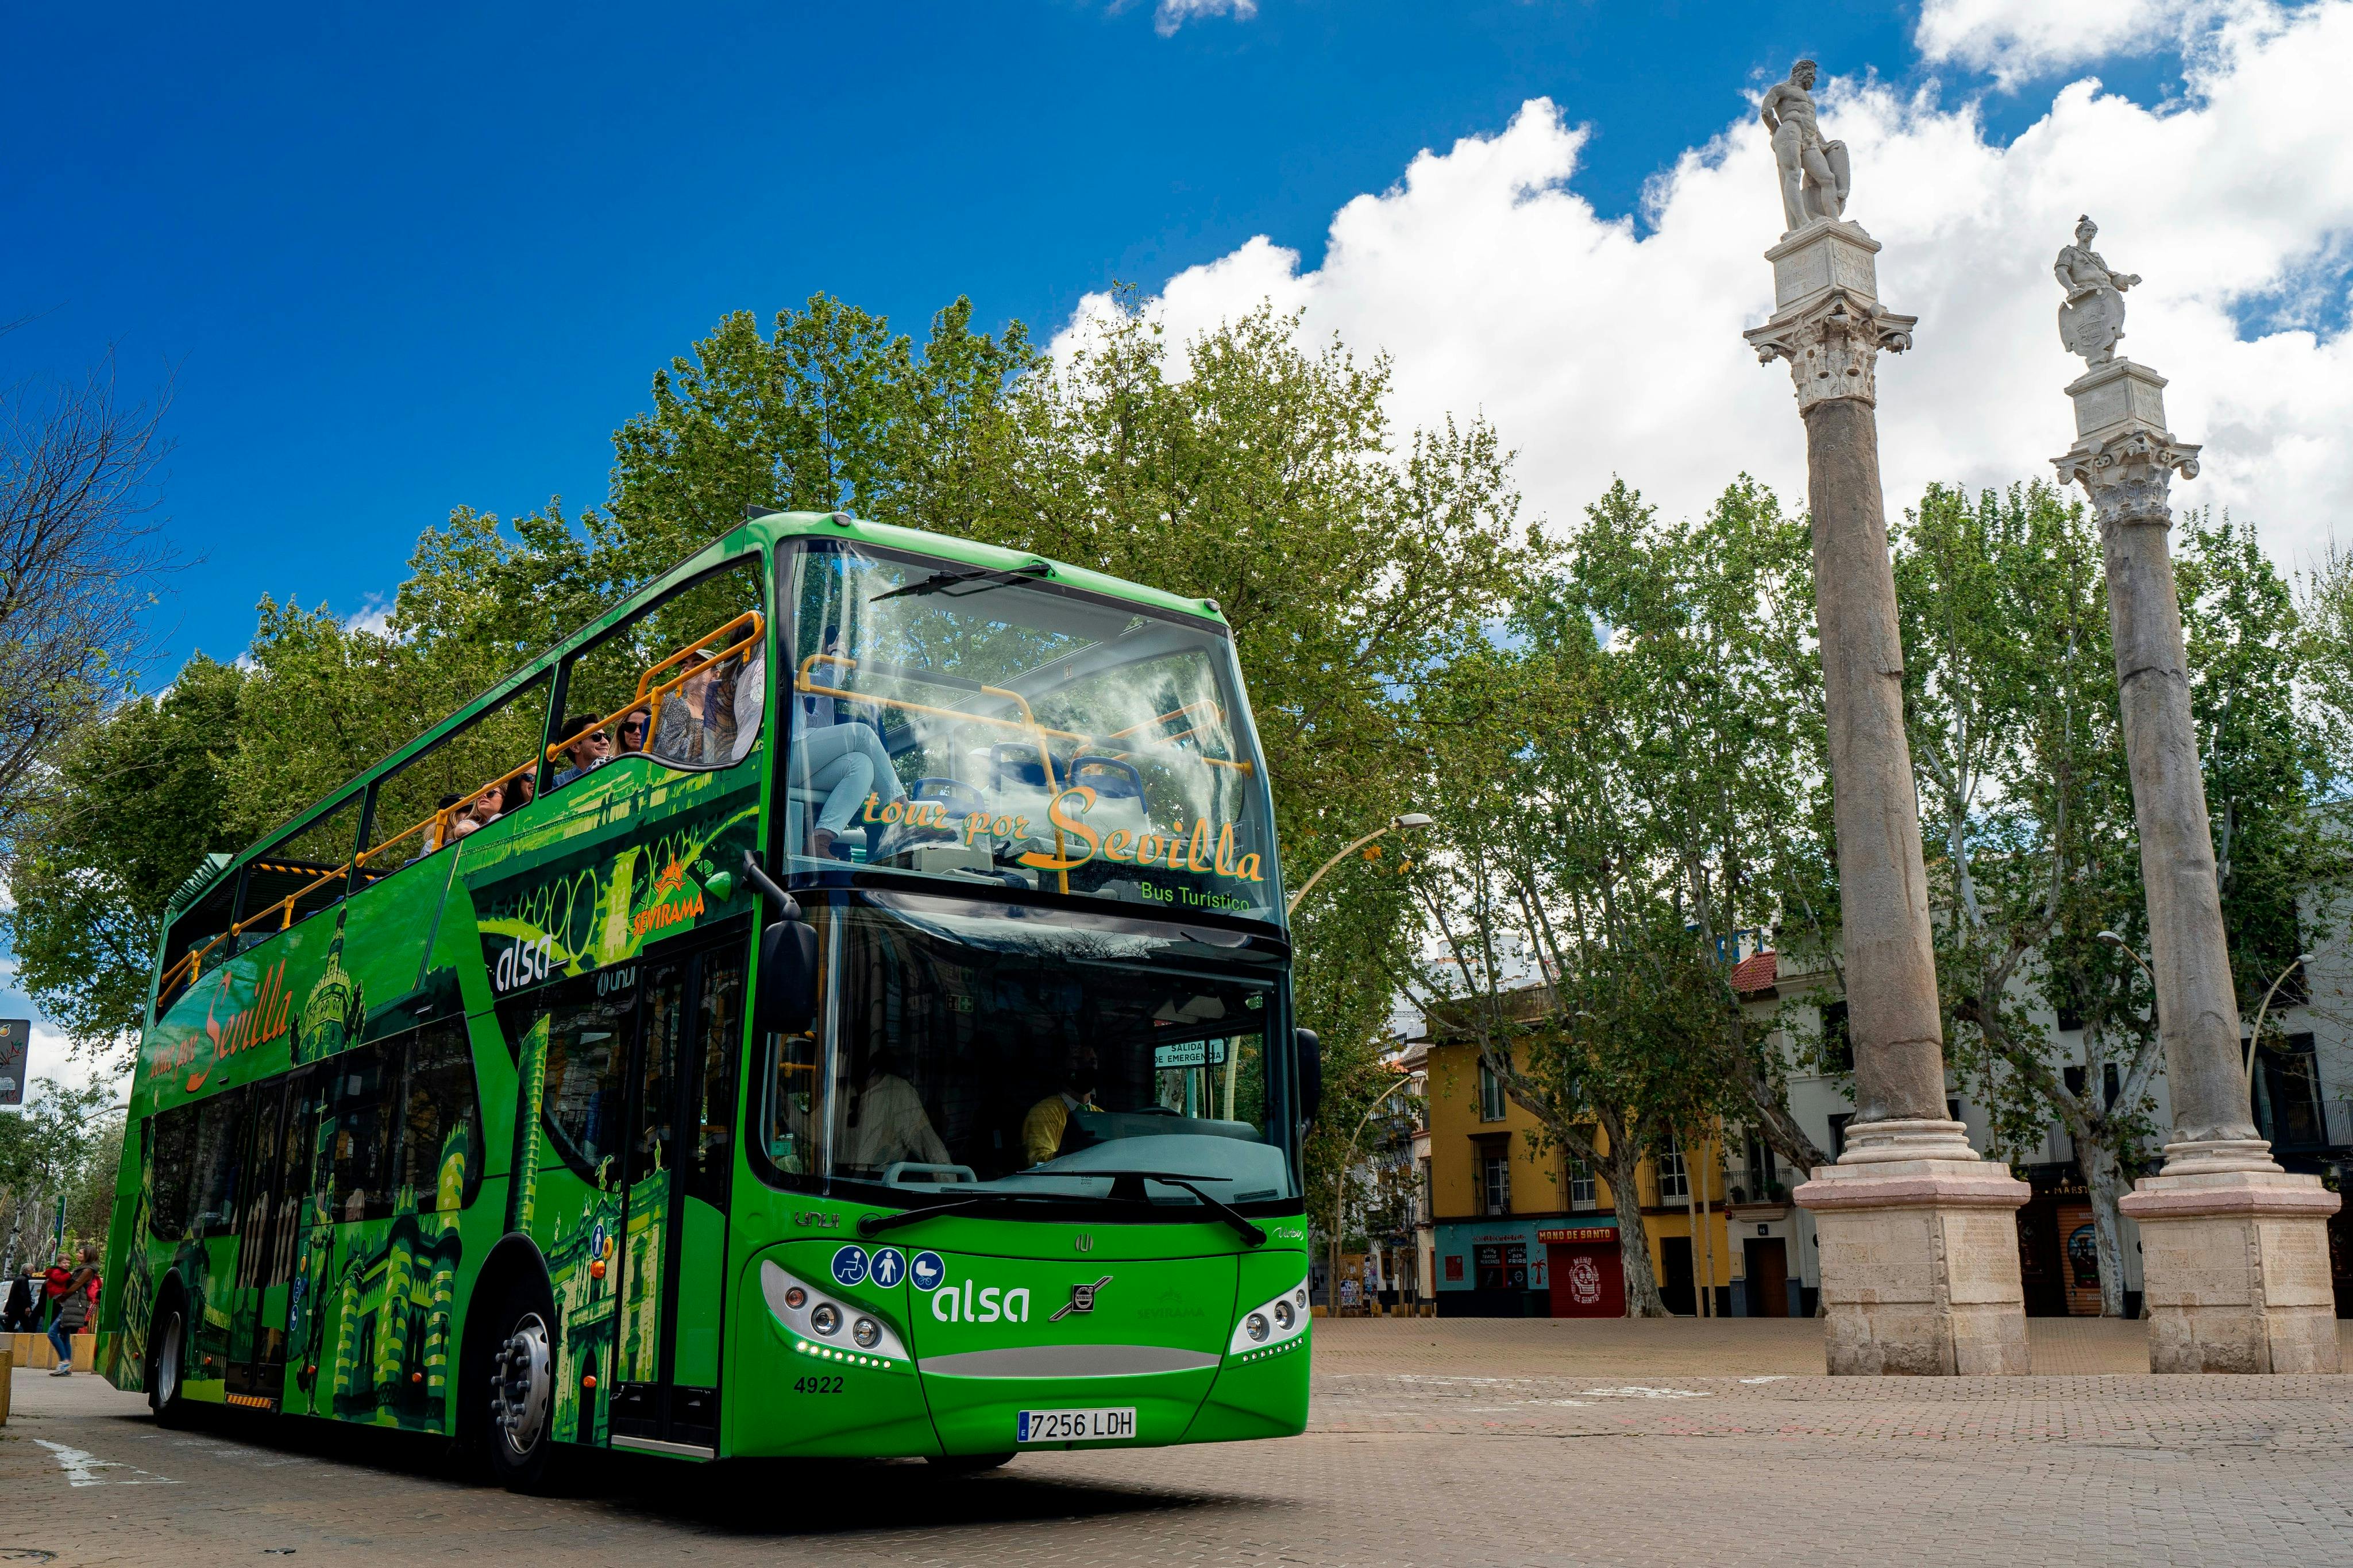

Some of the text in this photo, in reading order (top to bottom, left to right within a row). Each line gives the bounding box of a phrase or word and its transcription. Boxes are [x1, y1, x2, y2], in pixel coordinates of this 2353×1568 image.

[862, 786, 1264, 882] tour por Sevilla
[1141, 881, 1250, 912] Bus Turístico
[632, 891, 705, 938] SEVIRAMA
[496, 934, 553, 992] alsa
[186, 957, 292, 1093] Sevilla
[1171, 1042, 1202, 1052] SALIDA
[1155, 1055, 1163, 1063] DE
[2054, 1185, 2088, 1195] MAEST
[1539, 1229, 1611, 1241] MANO DE SANTO
[1507, 1246, 1527, 1254] CHELAS
[1573, 1256, 1592, 1266] MANO
[931, 1279, 1030, 1323] alsa
[1581, 1293, 1600, 1304] SANTO
[793, 1376, 844, 1394] 4922
[1031, 1412, 1132, 1438] 7256 LDH
